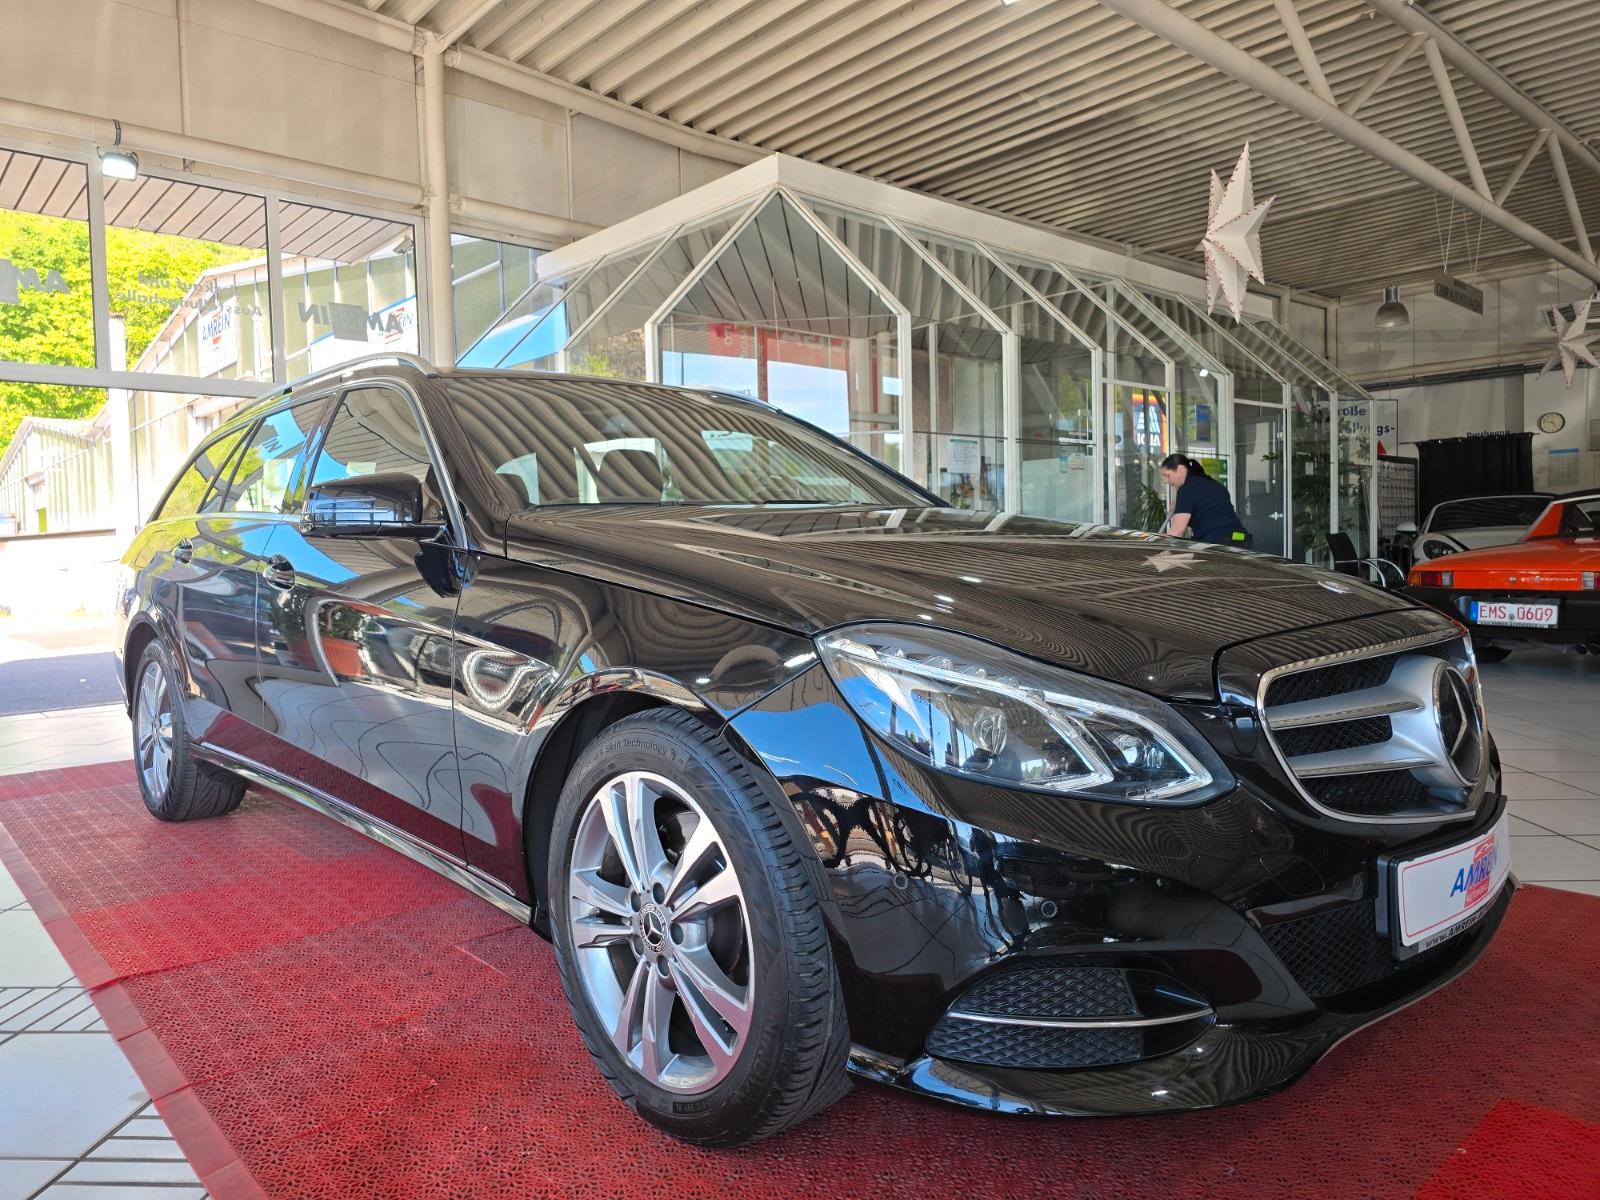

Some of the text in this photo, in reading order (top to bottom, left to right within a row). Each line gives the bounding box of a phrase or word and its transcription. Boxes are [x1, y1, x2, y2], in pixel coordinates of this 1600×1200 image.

[202, 312, 231, 344] AMREIN
[1337, 405, 1367, 417] roße
[1479, 604, 1553, 622] EMS 0609
[623, 738, 668, 755] Technology
